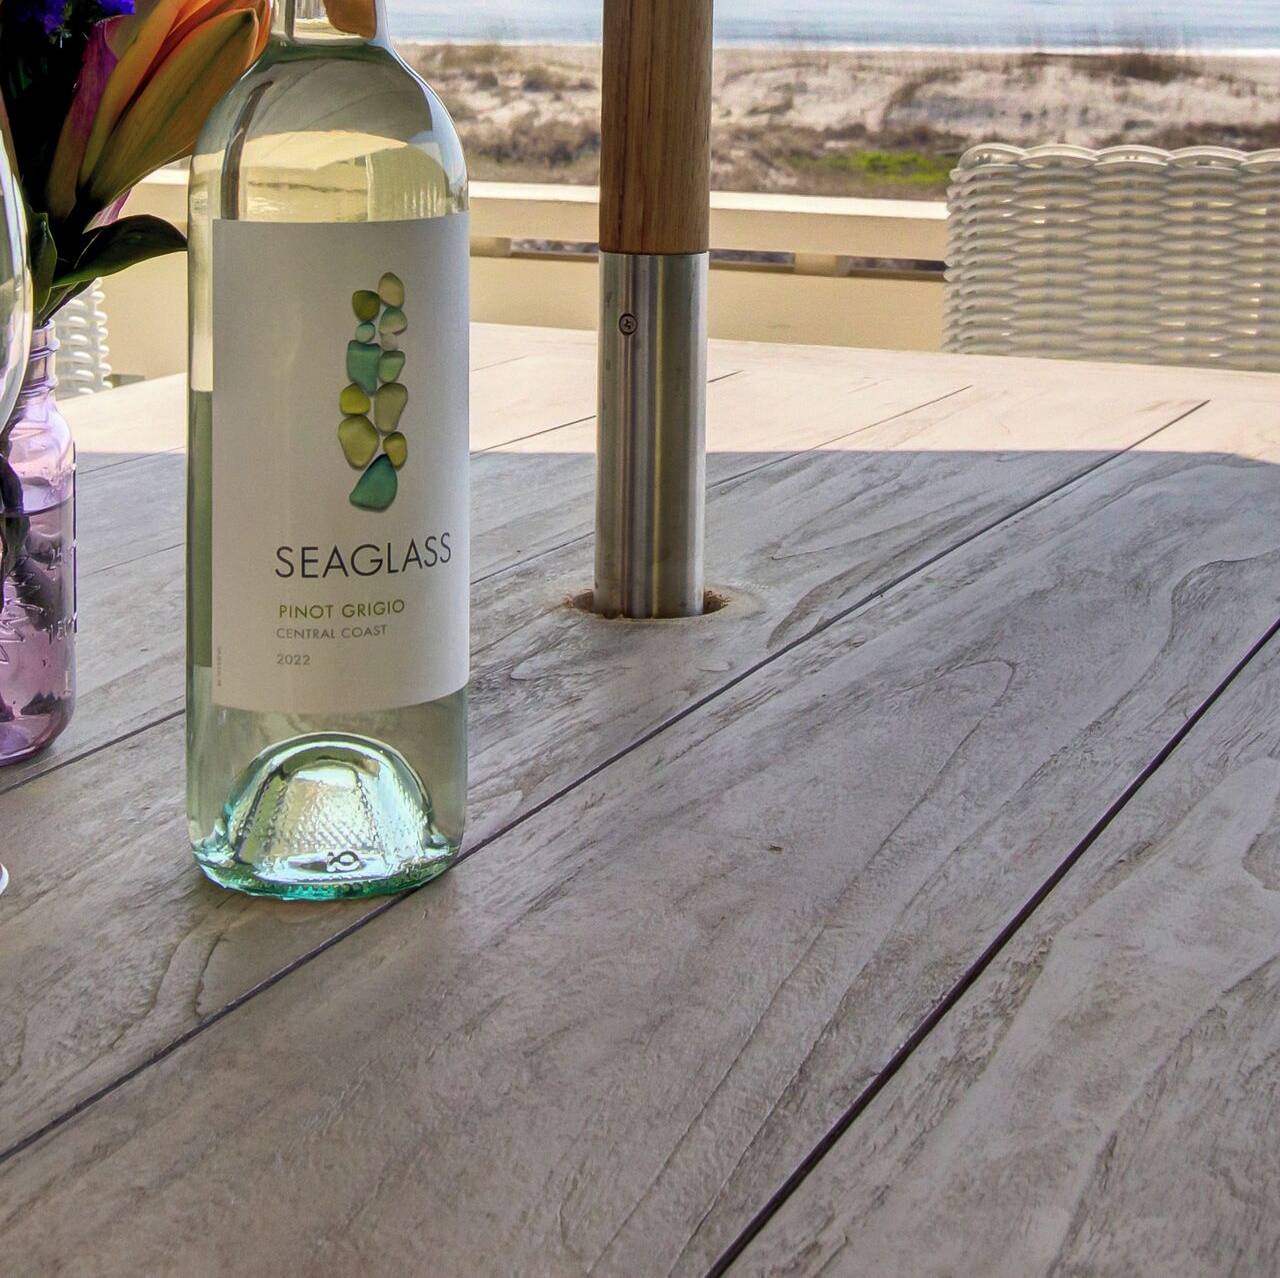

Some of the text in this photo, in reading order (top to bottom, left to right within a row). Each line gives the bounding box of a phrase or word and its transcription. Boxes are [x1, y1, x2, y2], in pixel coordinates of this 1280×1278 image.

[275, 532, 451, 578] SEAGLASS
[278, 599, 405, 620] PINOT GRIGIO
[276, 624, 388, 640] CENTRAL COAST
[276, 654, 311, 666] 2022
